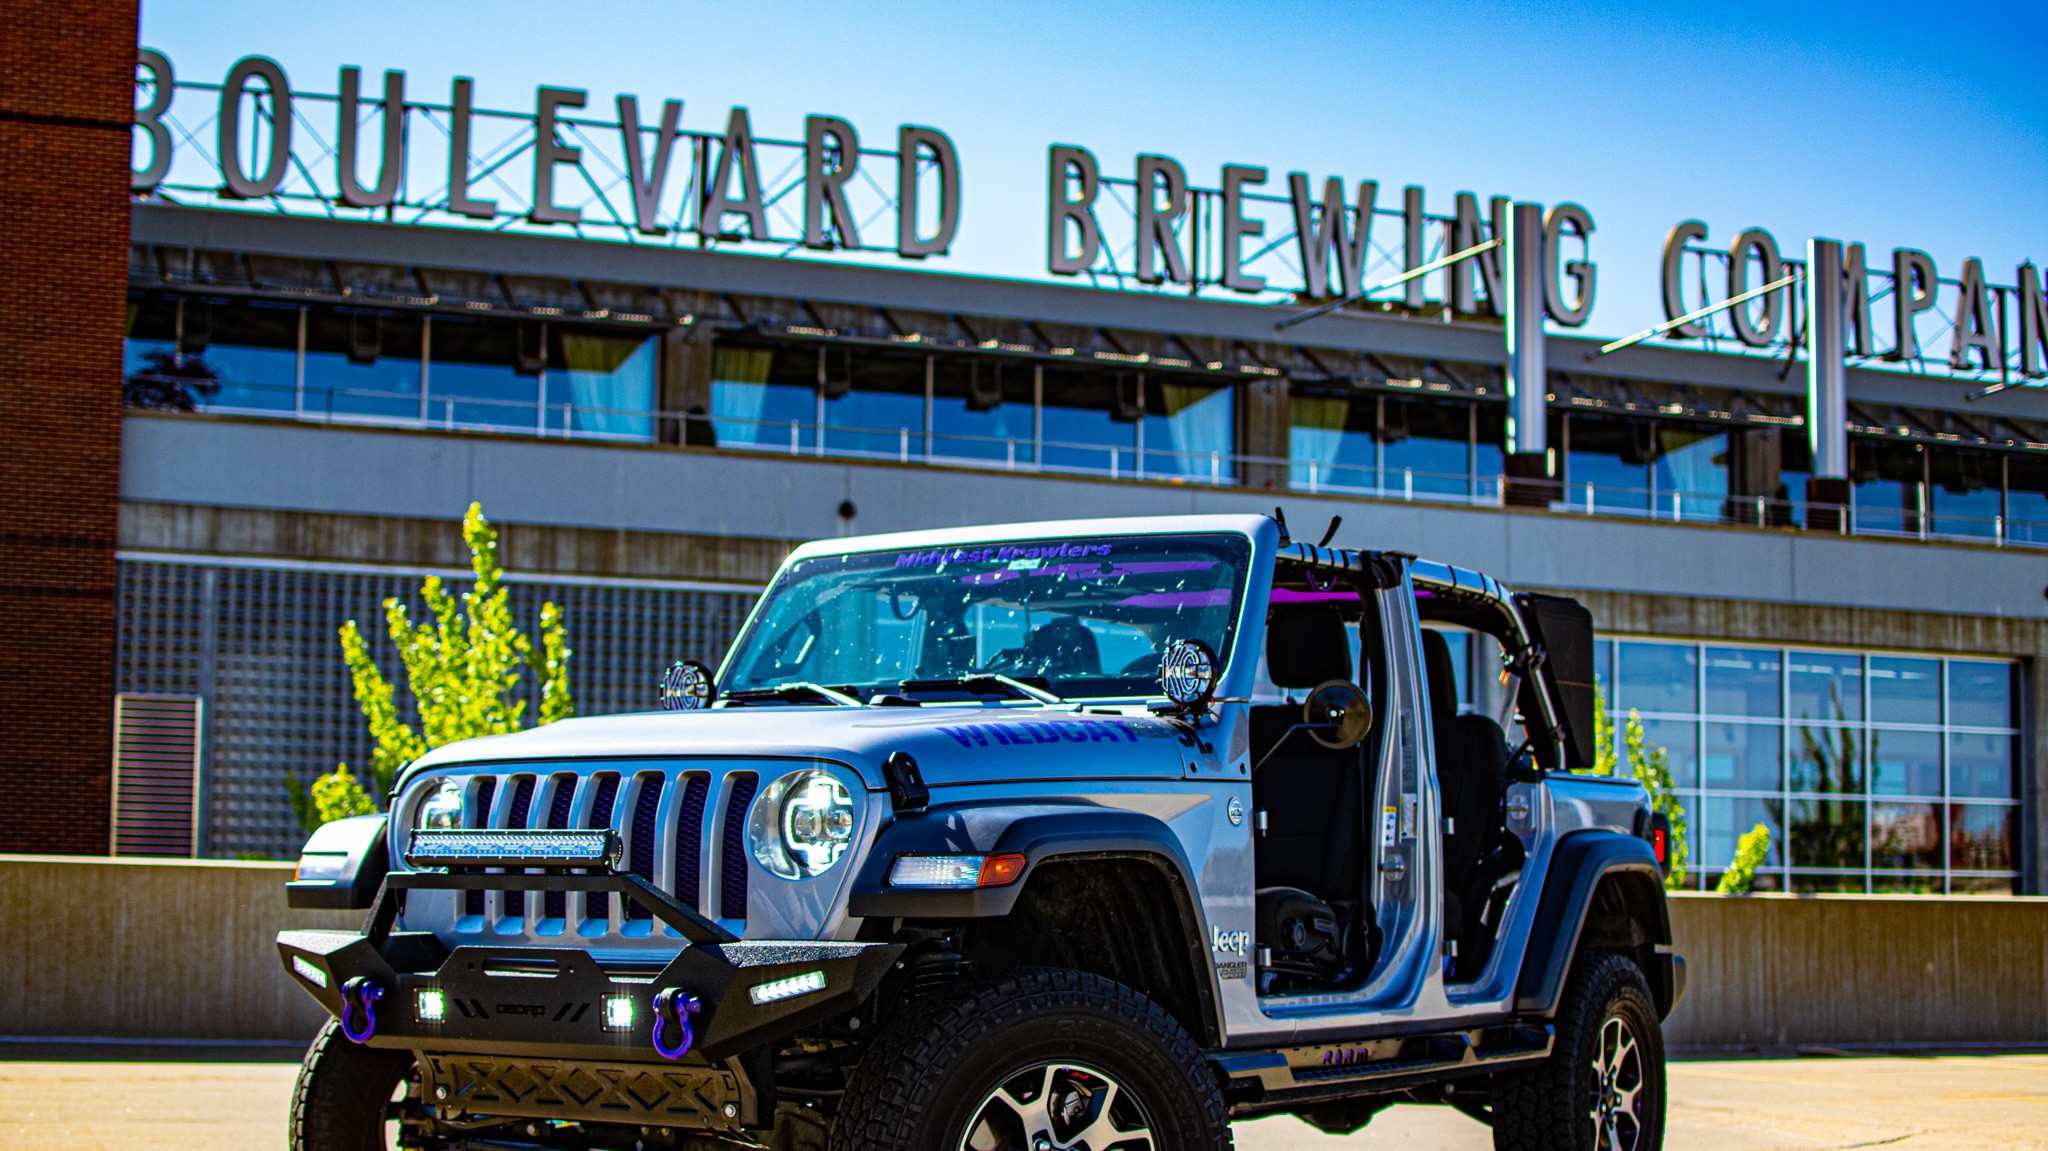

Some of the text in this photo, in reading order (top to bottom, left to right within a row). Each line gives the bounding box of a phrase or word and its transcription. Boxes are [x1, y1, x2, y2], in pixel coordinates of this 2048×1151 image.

[131, 48, 961, 257] BOULEVARD
[1047, 143, 1597, 326] BREWING
[895, 543, 1112, 568] Midwest Krawlers
[1162, 645, 1200, 699] KC
[935, 720, 1138, 748] WILDCAT
[1211, 925, 1249, 957] Jeep
